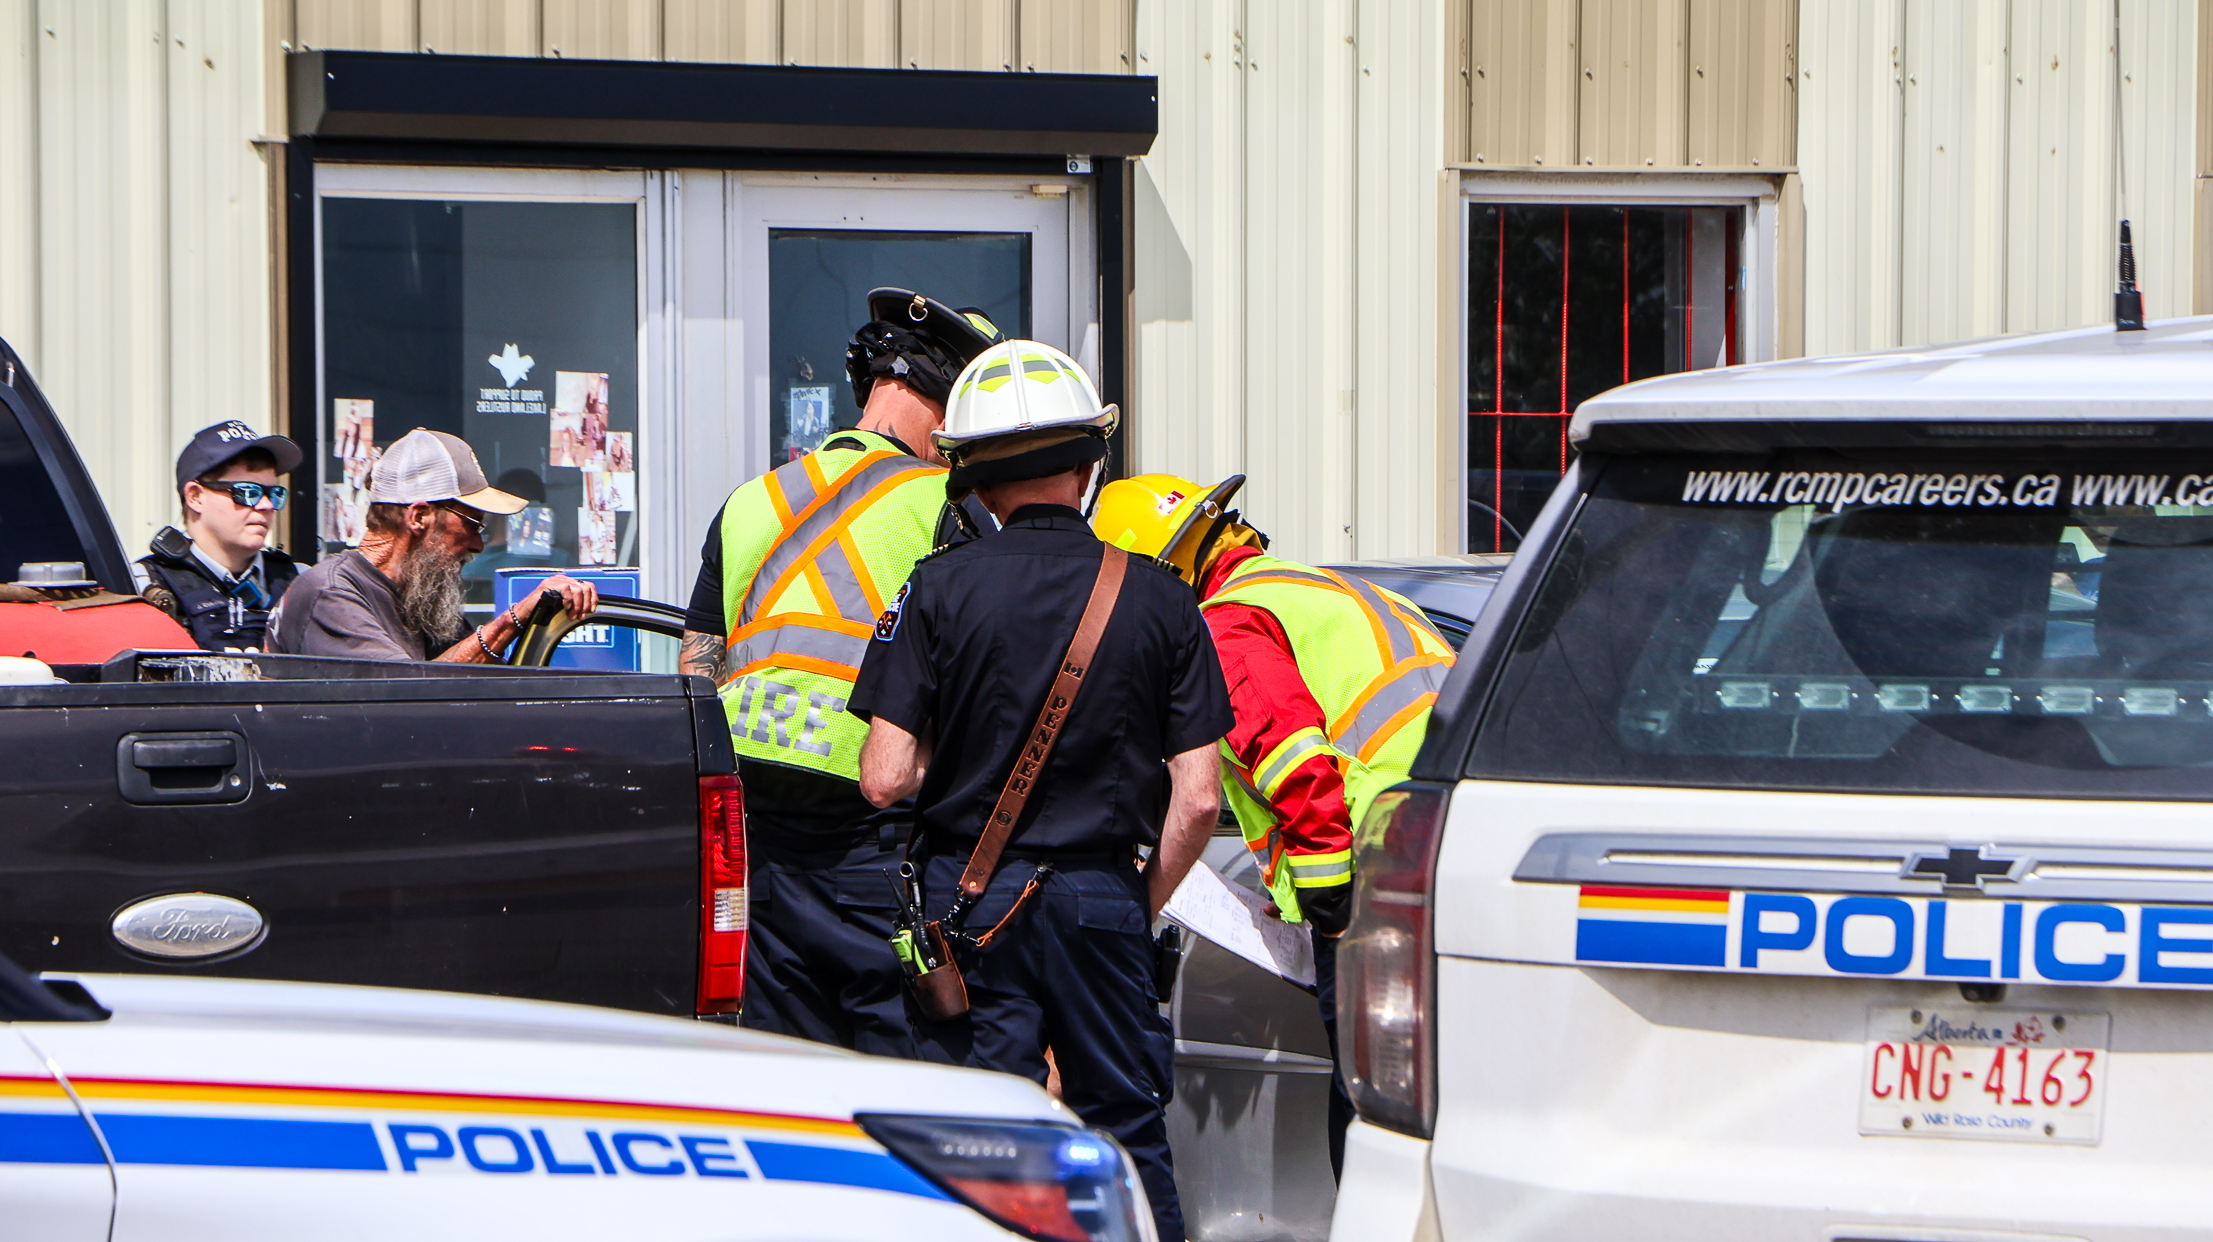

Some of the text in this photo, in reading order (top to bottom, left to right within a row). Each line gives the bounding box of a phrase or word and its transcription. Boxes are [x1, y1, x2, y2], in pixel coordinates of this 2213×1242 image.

[1682, 471, 2062, 514] www.rcmpcareers.ca
[1010, 694, 1068, 797] PENNER
[151, 907, 231, 942] Ford
[1740, 893, 2213, 985] POLICE
[1912, 1013, 1991, 1042] Alberta
[1871, 1042, 2096, 1108] CNG-4163
[1921, 1112, 2036, 1130] Wild Rose County
[387, 1124, 749, 1179] POLICE
